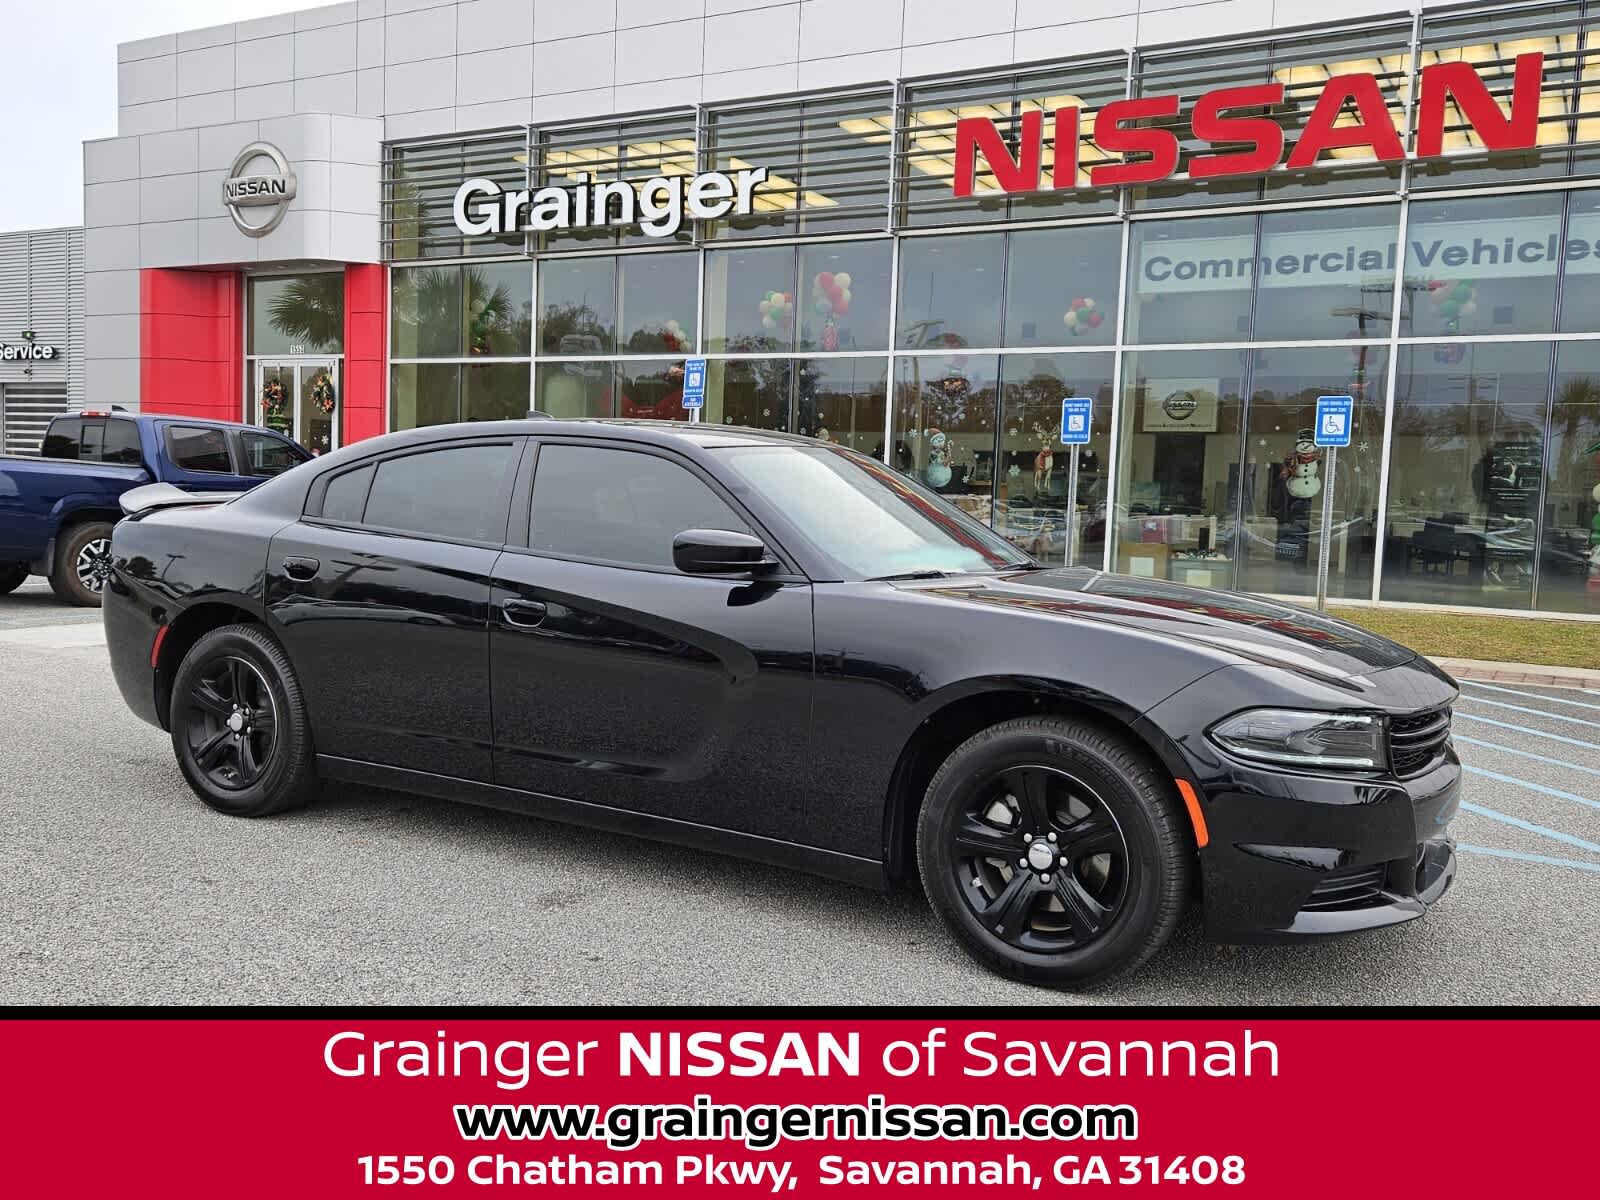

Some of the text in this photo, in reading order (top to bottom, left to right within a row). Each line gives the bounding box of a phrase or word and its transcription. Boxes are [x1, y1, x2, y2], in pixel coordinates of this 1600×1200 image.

[953, 51, 1544, 198] NISSAN
[226, 179, 286, 197] NISSAN
[453, 166, 768, 238] Grainger
[1144, 242, 1397, 282] Commercial
